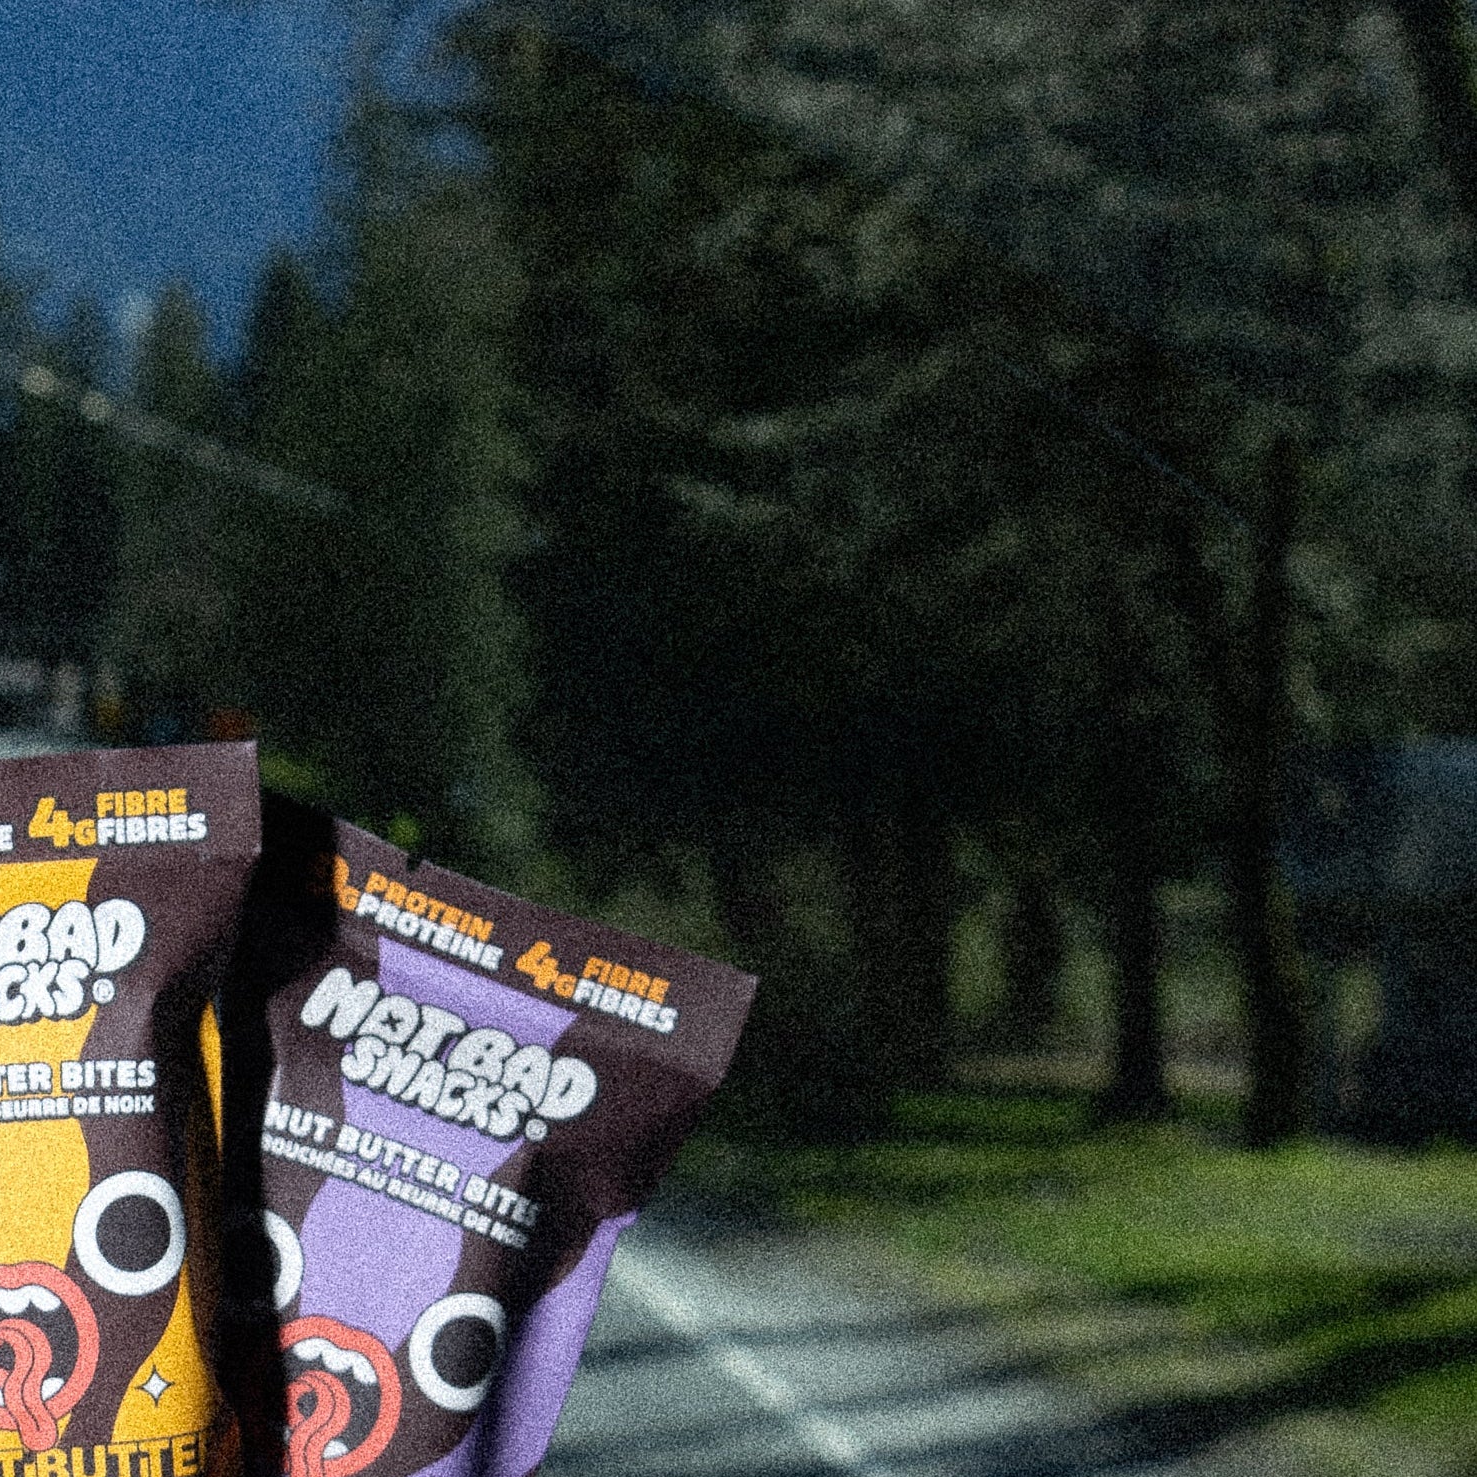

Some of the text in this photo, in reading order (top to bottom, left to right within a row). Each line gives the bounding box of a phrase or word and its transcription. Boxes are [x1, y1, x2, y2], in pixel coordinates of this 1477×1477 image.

[96, 788, 188, 818] FIBRE
[97, 813, 207, 848] FIBRES
[355, 892, 504, 972] PROTÉINE
[366, 871, 495, 943] PROTEIN
[573, 978, 680, 1034] FIBRES
[582, 956, 672, 1005] FIBRE
[300, 966, 598, 1121] NOT BAD
[61, 1060, 156, 1090] BITES
[74, 1097, 100, 1116] DE
[105, 1094, 155, 1115] NOIX
[340, 1034, 531, 1141] SNACKS
[263, 1100, 334, 1142] NUT
[335, 1123, 460, 1194] BUTTER
[356, 1167, 388, 1191] AU
[462, 1208, 492, 1235] DE
